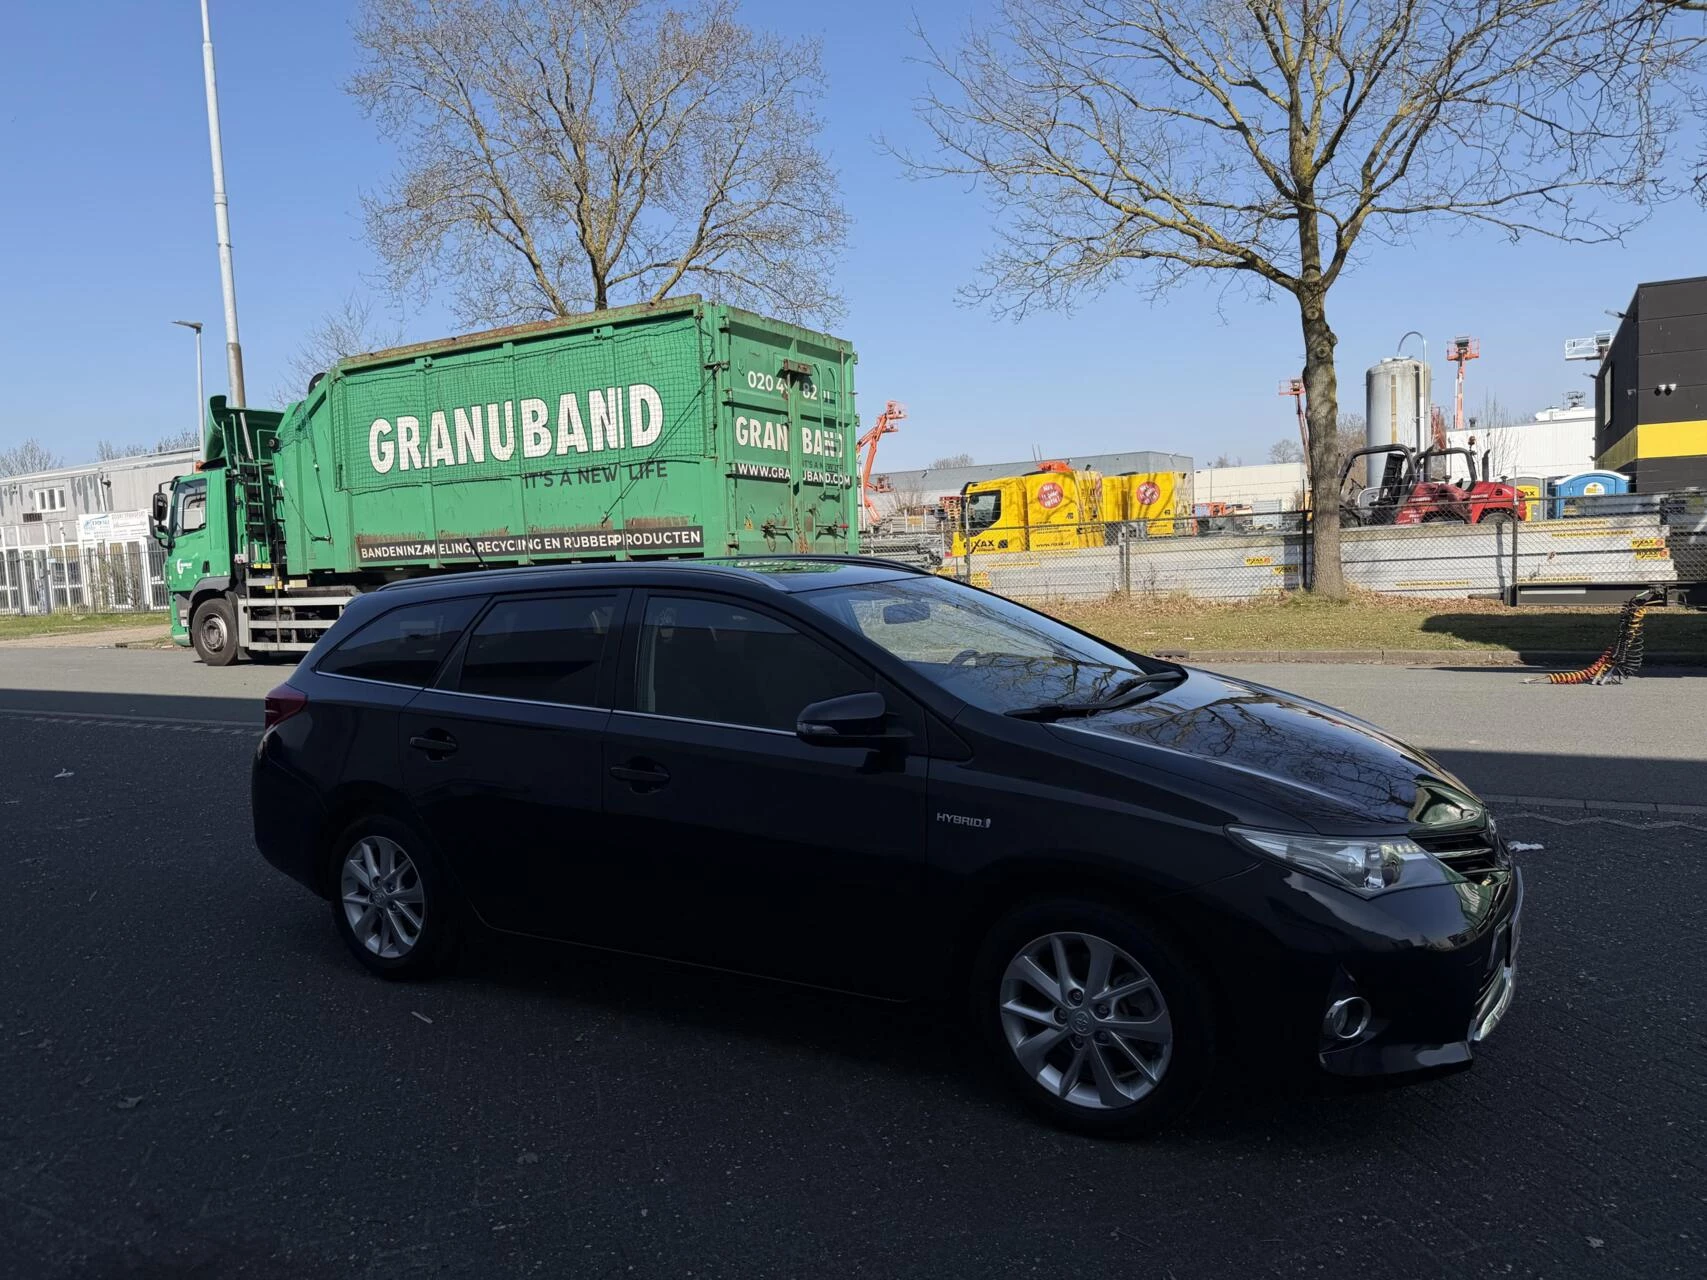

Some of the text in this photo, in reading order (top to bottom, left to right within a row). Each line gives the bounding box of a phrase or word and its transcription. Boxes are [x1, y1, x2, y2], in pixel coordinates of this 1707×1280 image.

[747, 370, 774, 392] 020
[368, 383, 664, 475] GRANUBAND
[523, 460, 669, 489] IT'S A NEW LIFE
[543, 537, 561, 550] EN
